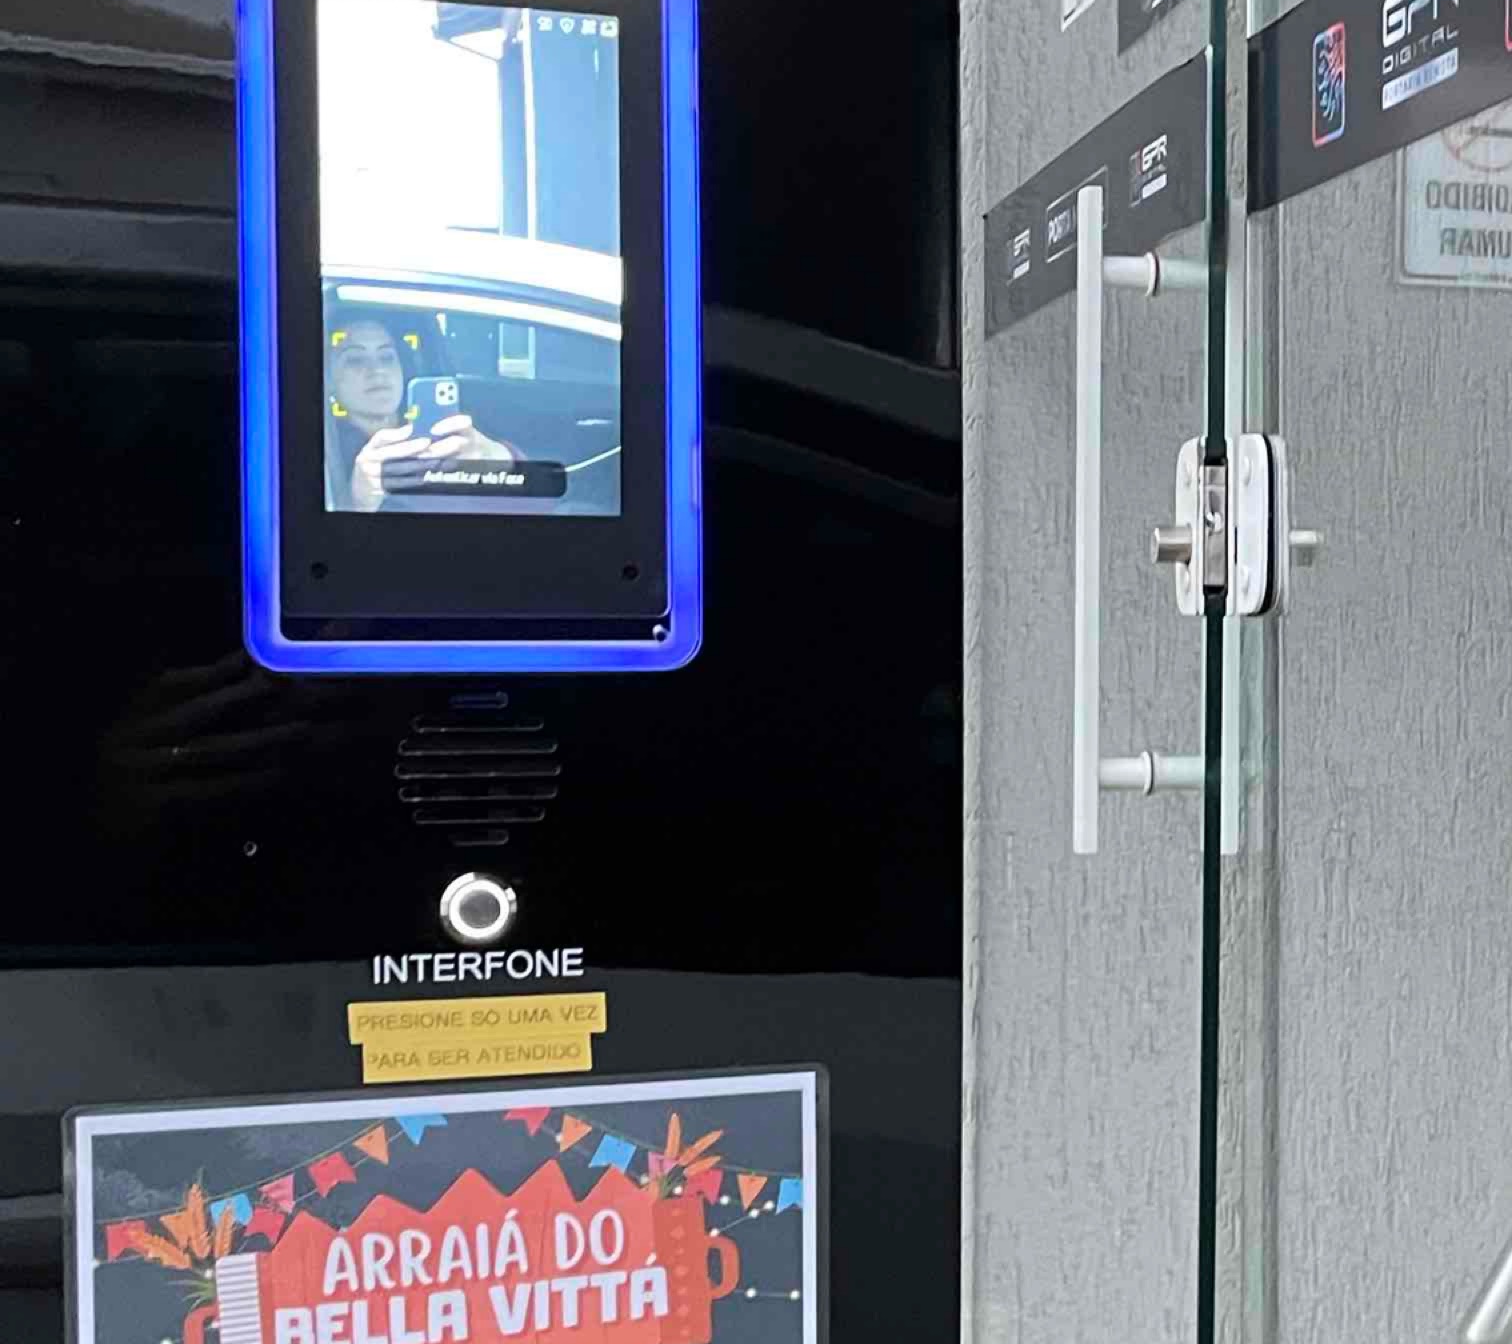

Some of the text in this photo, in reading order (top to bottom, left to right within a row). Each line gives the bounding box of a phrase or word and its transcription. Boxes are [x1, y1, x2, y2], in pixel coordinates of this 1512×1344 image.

[1382, 23, 1459, 74] DIGITAL
[1142, 134, 1167, 172] GPR
[372, 947, 584, 984] INTERFONE
[357, 1010, 463, 1031] PRESIONE
[507, 1007, 552, 1026] UMA
[560, 1004, 598, 1022] VEZ
[366, 1042, 582, 1071] PARA SER ATENDIDO
[323, 1208, 625, 1297] ARRAIÁ DO
[488, 1252, 669, 1336] VITTÁ
